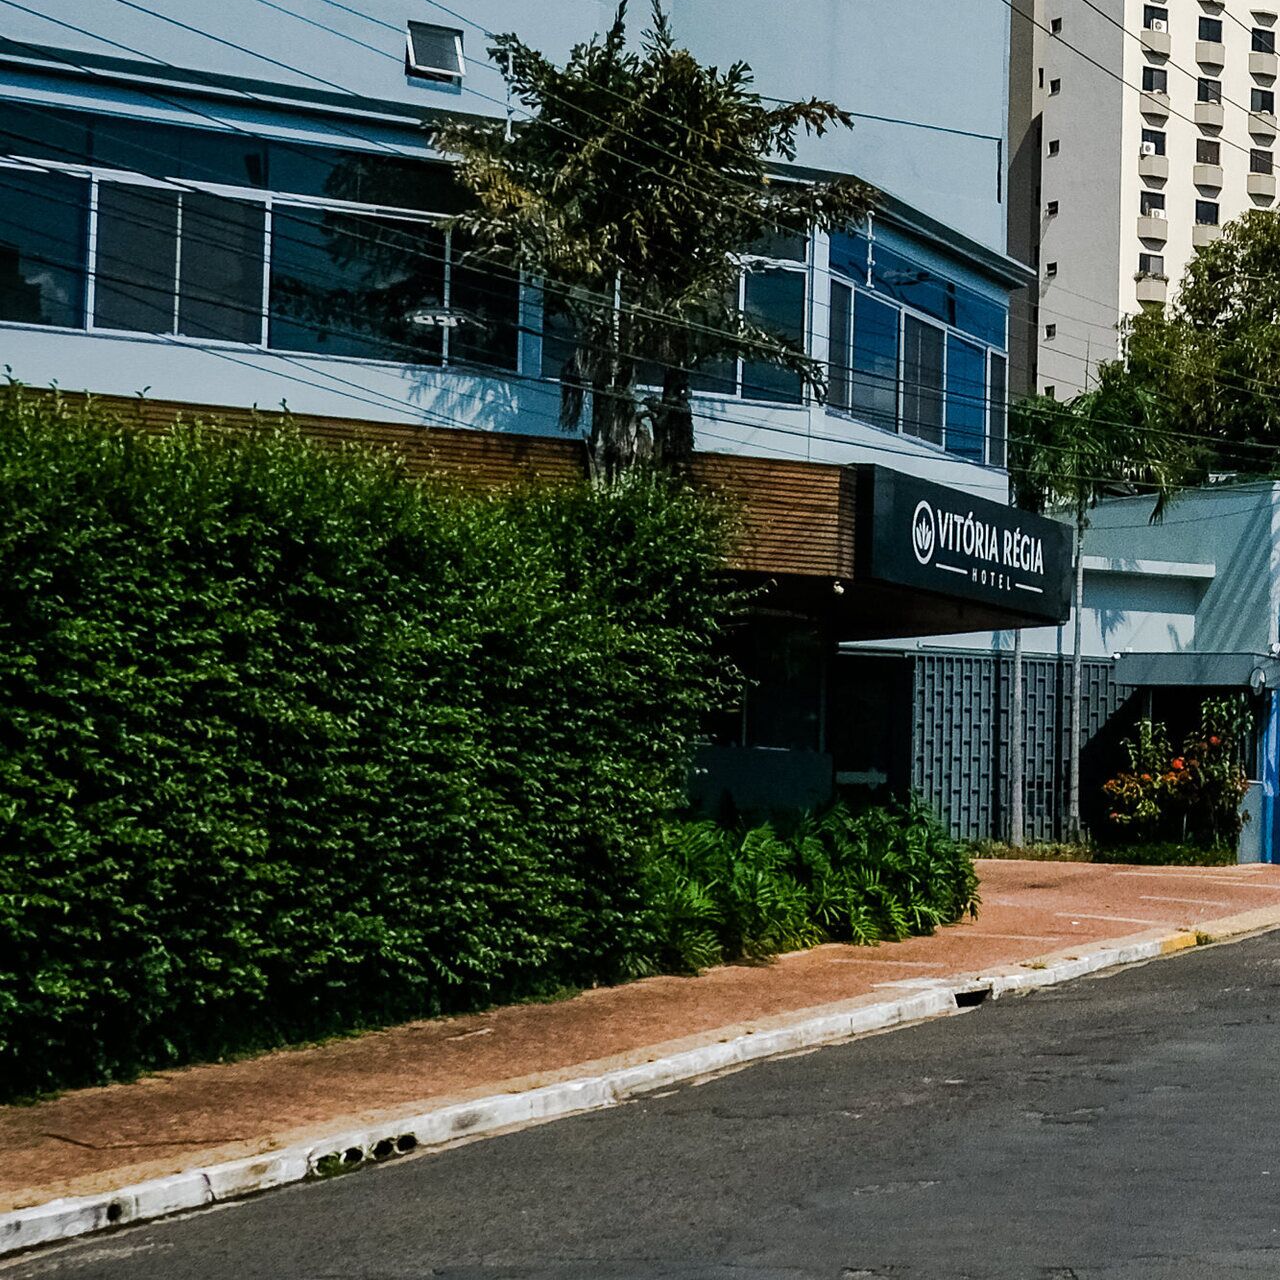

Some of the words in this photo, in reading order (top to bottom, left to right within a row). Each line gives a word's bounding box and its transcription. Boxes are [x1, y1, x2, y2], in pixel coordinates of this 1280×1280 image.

[937, 508, 999, 563] VITÓRIA
[1003, 527, 1044, 575] RÉGIA
[972, 568, 1011, 591] HOTEL
